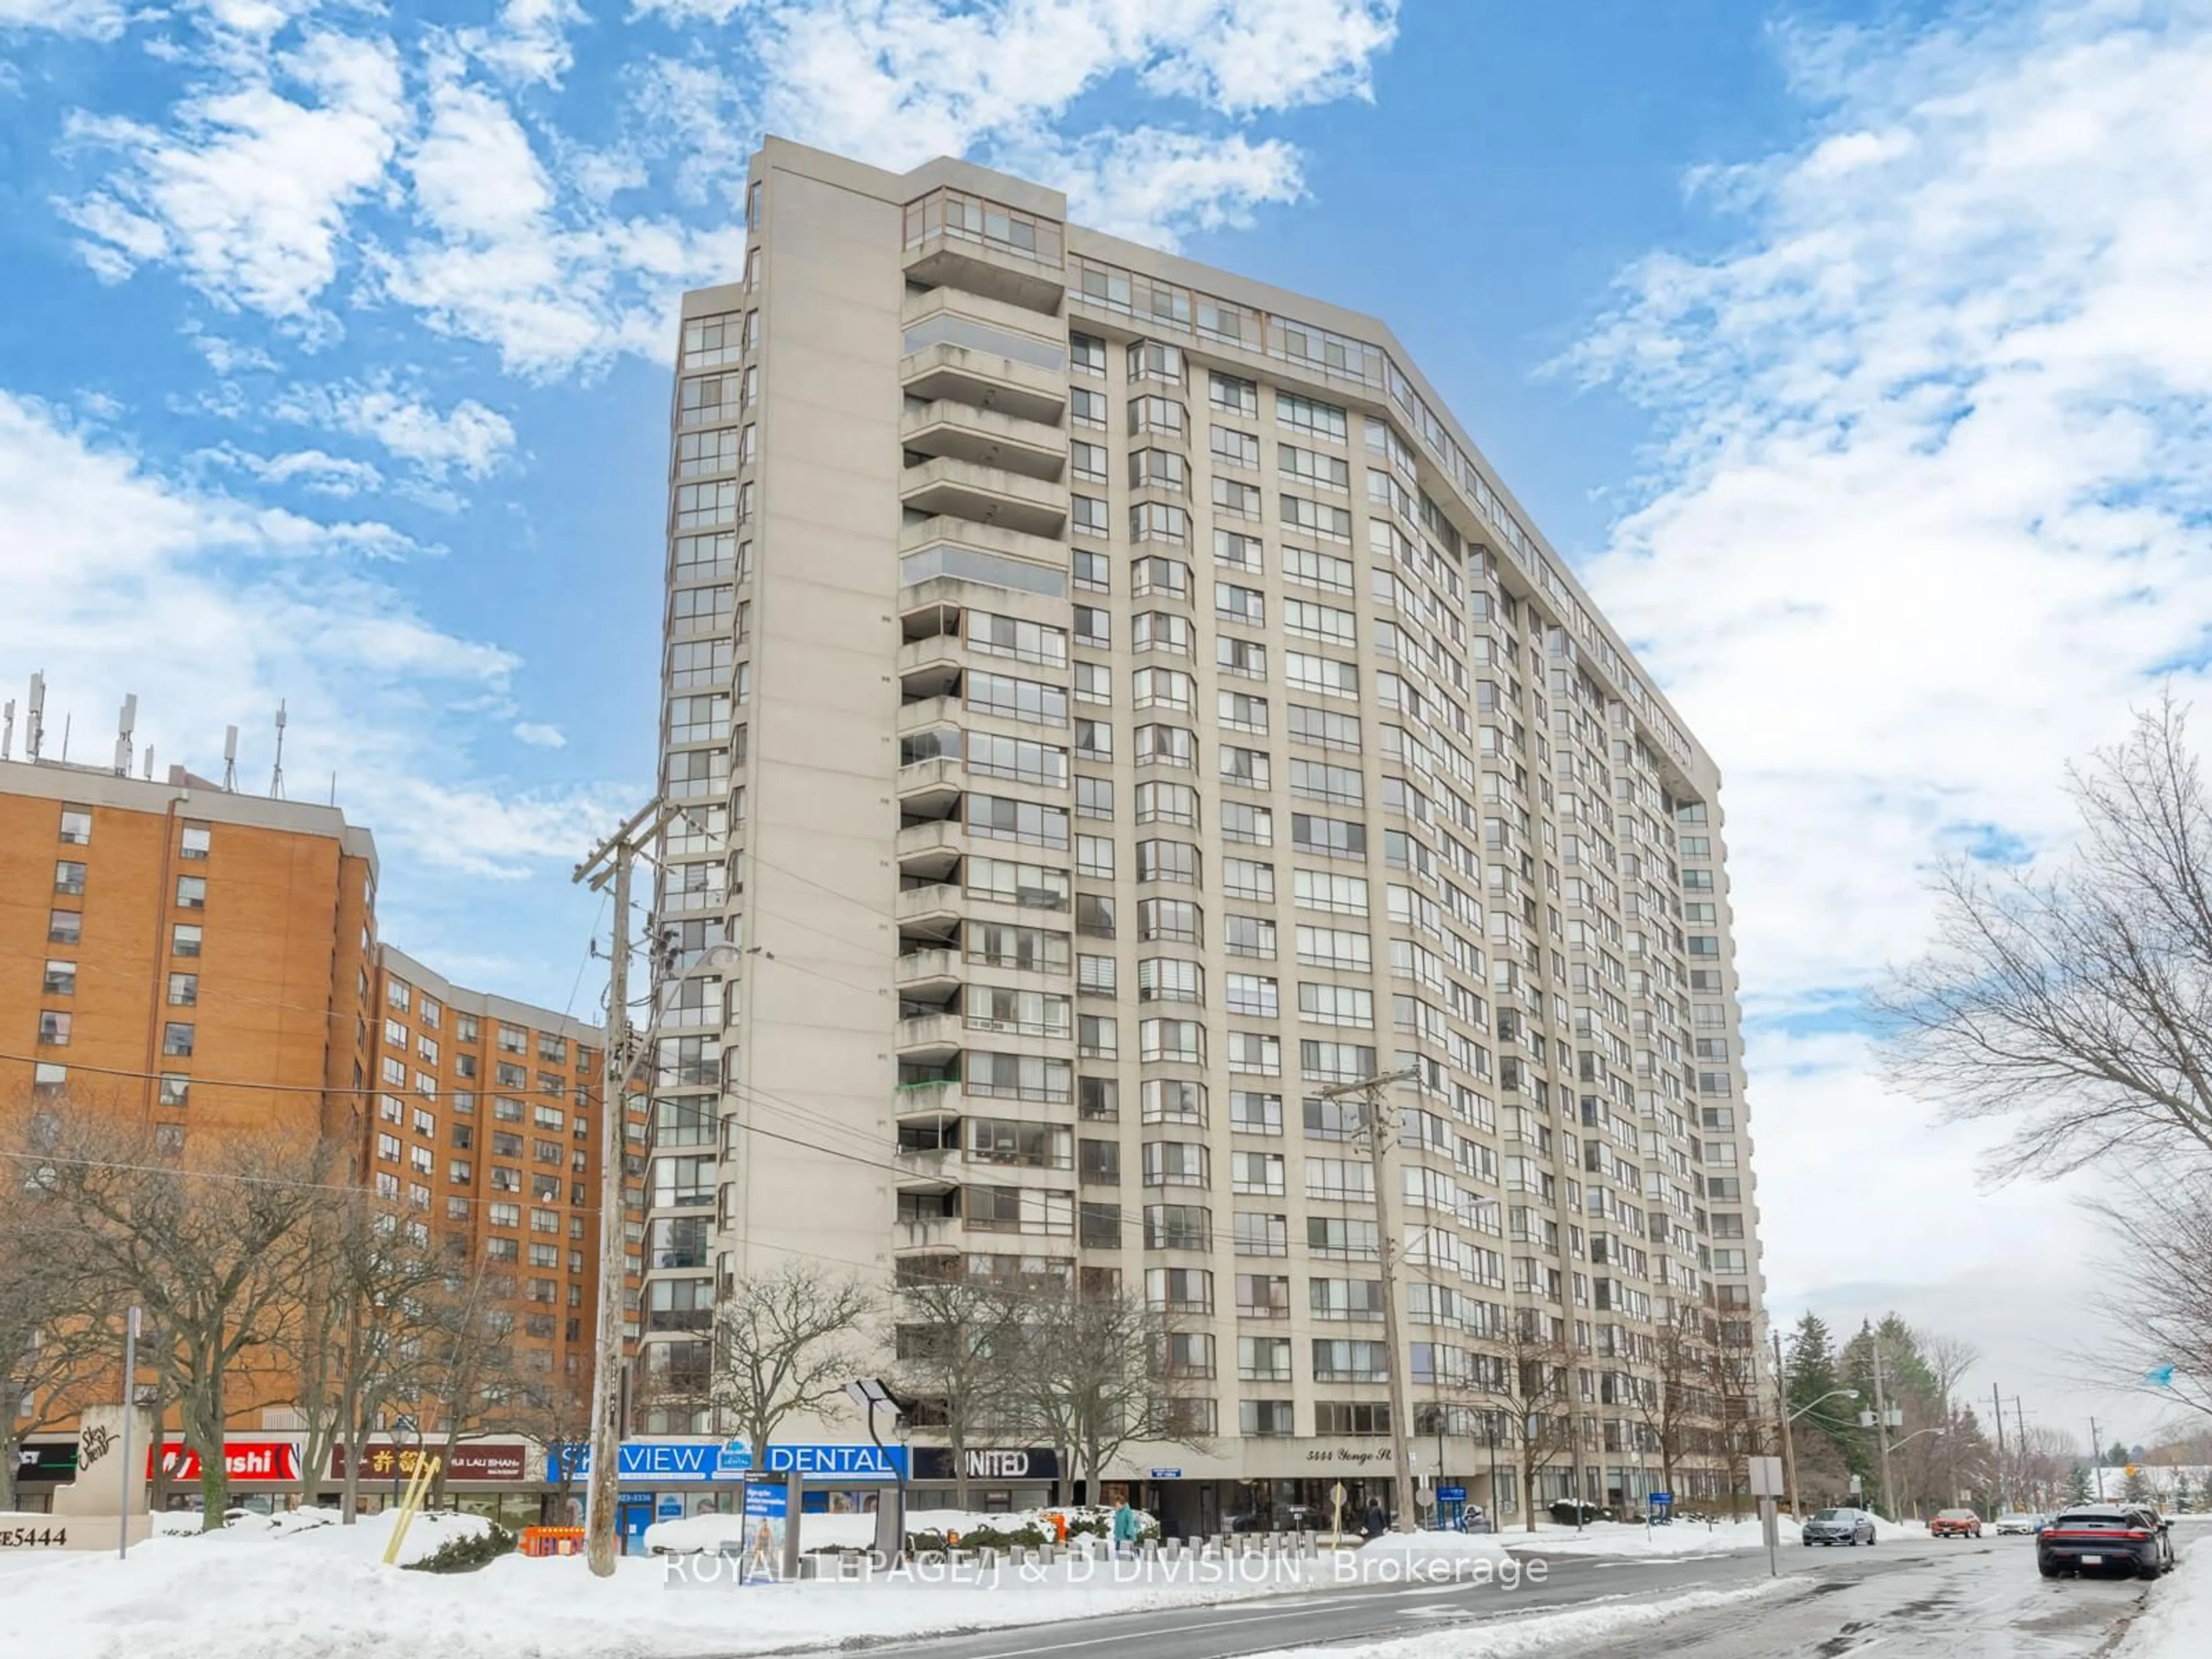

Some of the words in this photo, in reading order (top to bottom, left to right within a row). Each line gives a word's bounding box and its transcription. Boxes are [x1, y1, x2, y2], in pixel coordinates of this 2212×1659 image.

[198, 1449, 271, 1472] shi
[562, 1447, 705, 1471] SVIEW
[771, 1448, 893, 1471] DENTAL
[1306, 1450, 1333, 1461] 5444
[1337, 1448, 1373, 1466] Yonge
